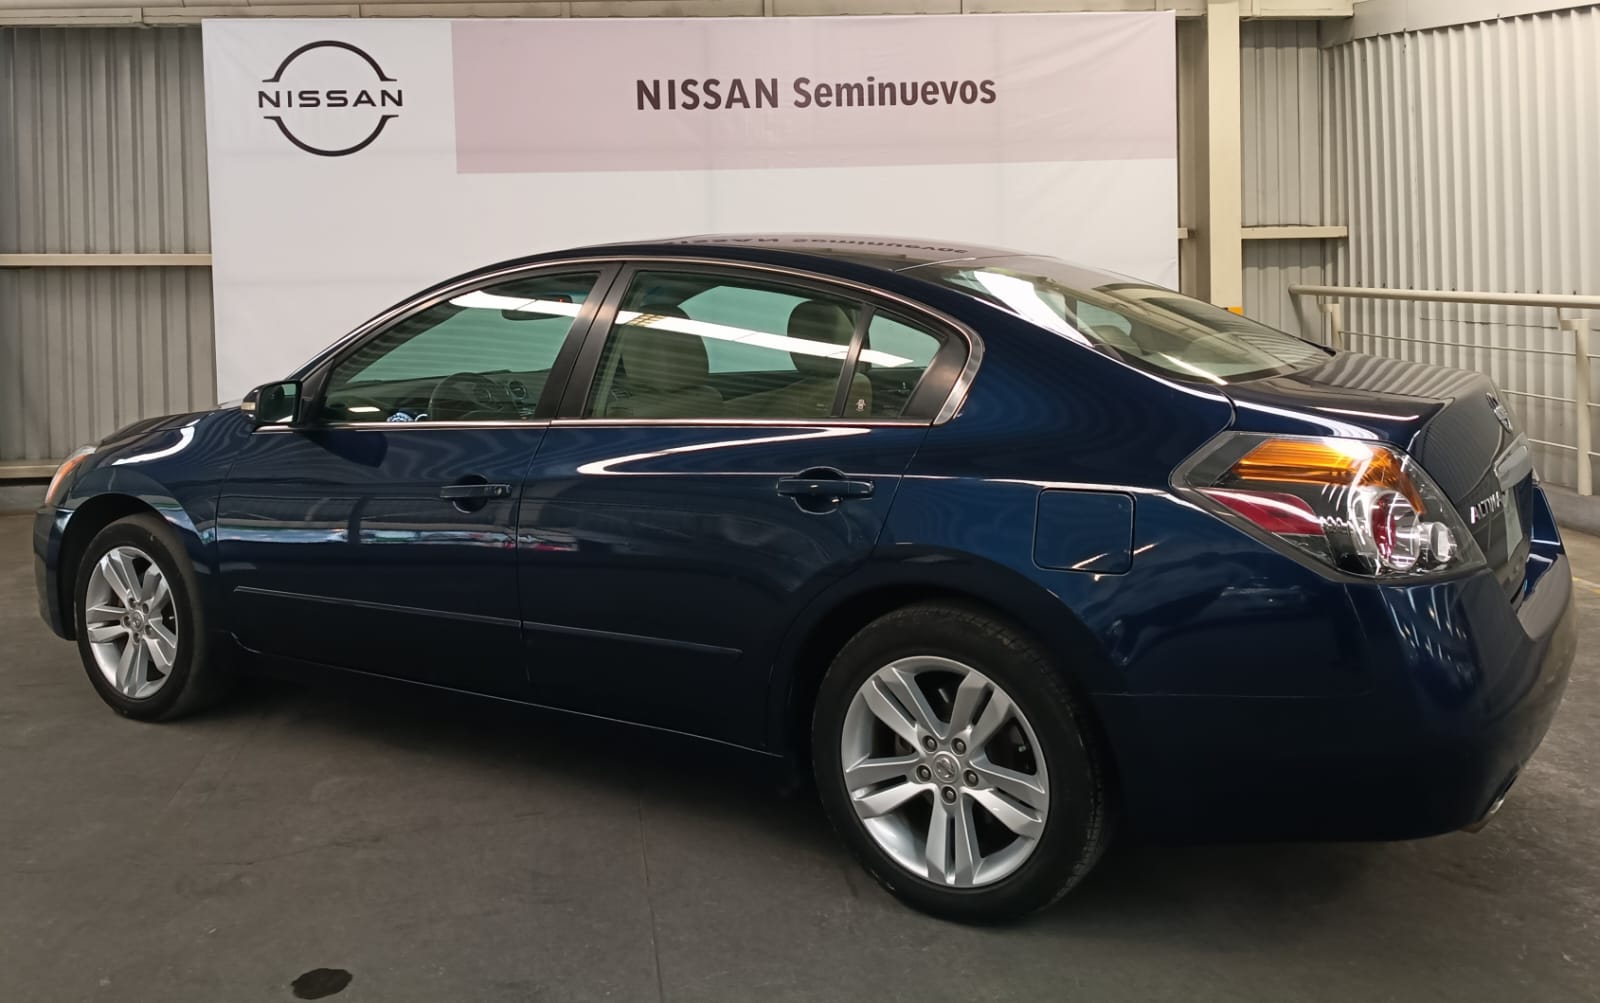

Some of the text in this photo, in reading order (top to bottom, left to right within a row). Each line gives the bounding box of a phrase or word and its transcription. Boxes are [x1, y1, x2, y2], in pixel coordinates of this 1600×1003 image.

[257, 89, 403, 108] NISSAN
[636, 76, 997, 110] NISSAN Seminuevos
